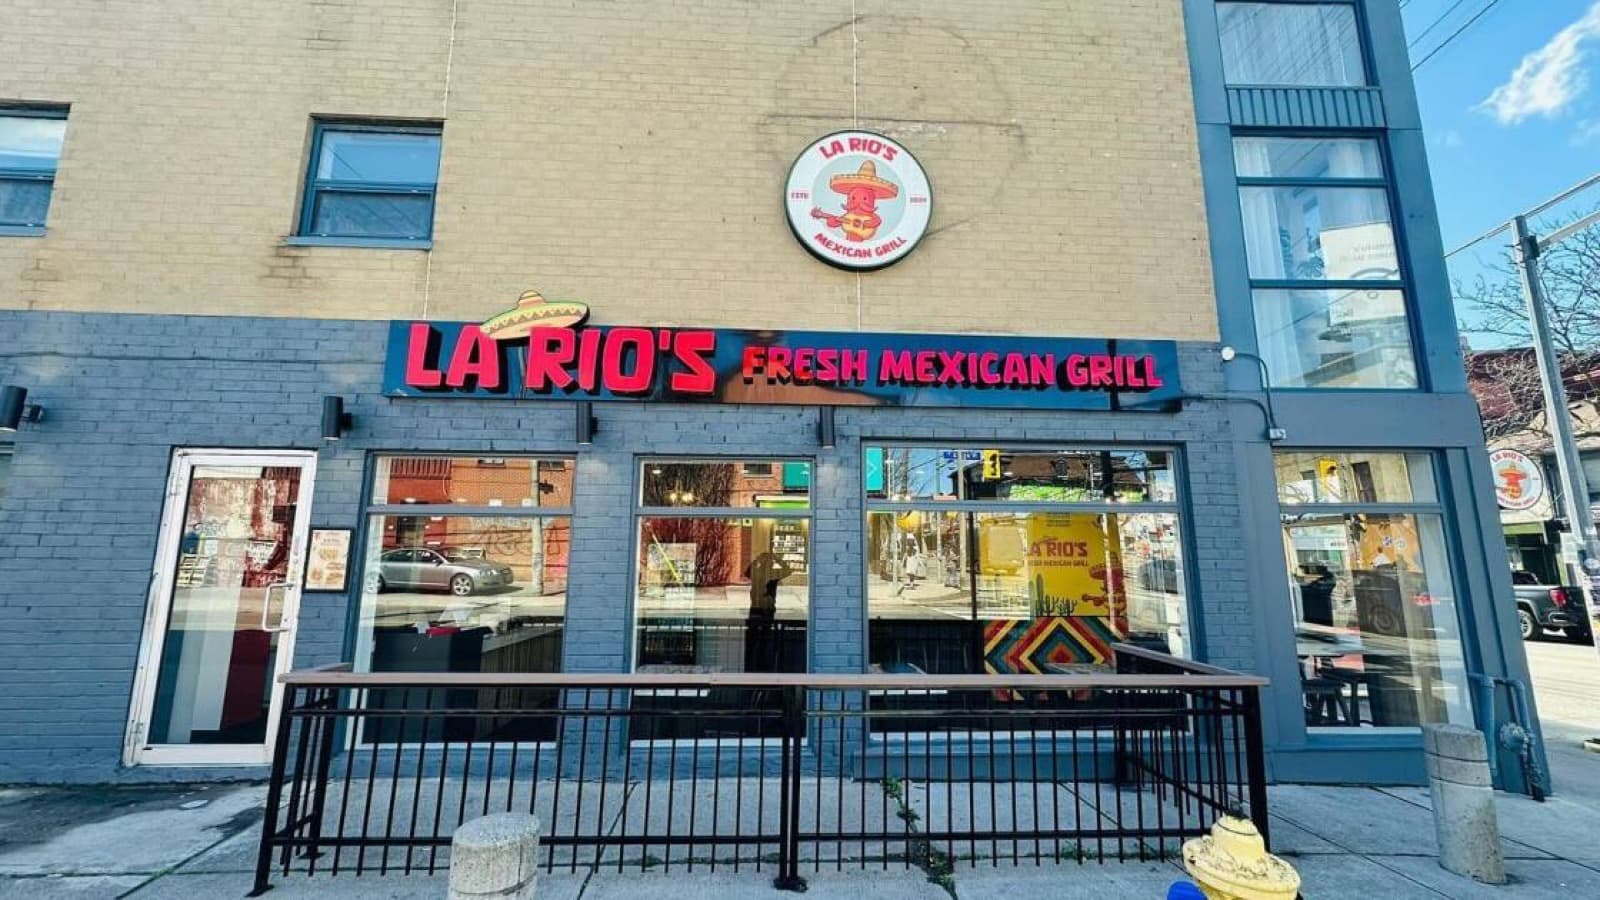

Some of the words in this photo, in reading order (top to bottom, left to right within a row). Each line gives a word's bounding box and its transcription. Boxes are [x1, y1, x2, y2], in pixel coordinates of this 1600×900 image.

[819, 140, 844, 159] LA
[848, 137, 898, 162] RIO'S
[814, 232, 872, 258] MEXICAN
[875, 236, 907, 255] GRILL
[406, 323, 499, 388] LA
[525, 327, 716, 393] RIO'S
[742, 347, 866, 381] FRESH
[880, 350, 1055, 385] MEXICAN
[1066, 354, 1164, 388] GRILL
[1046, 541, 1088, 557] RIO'S
